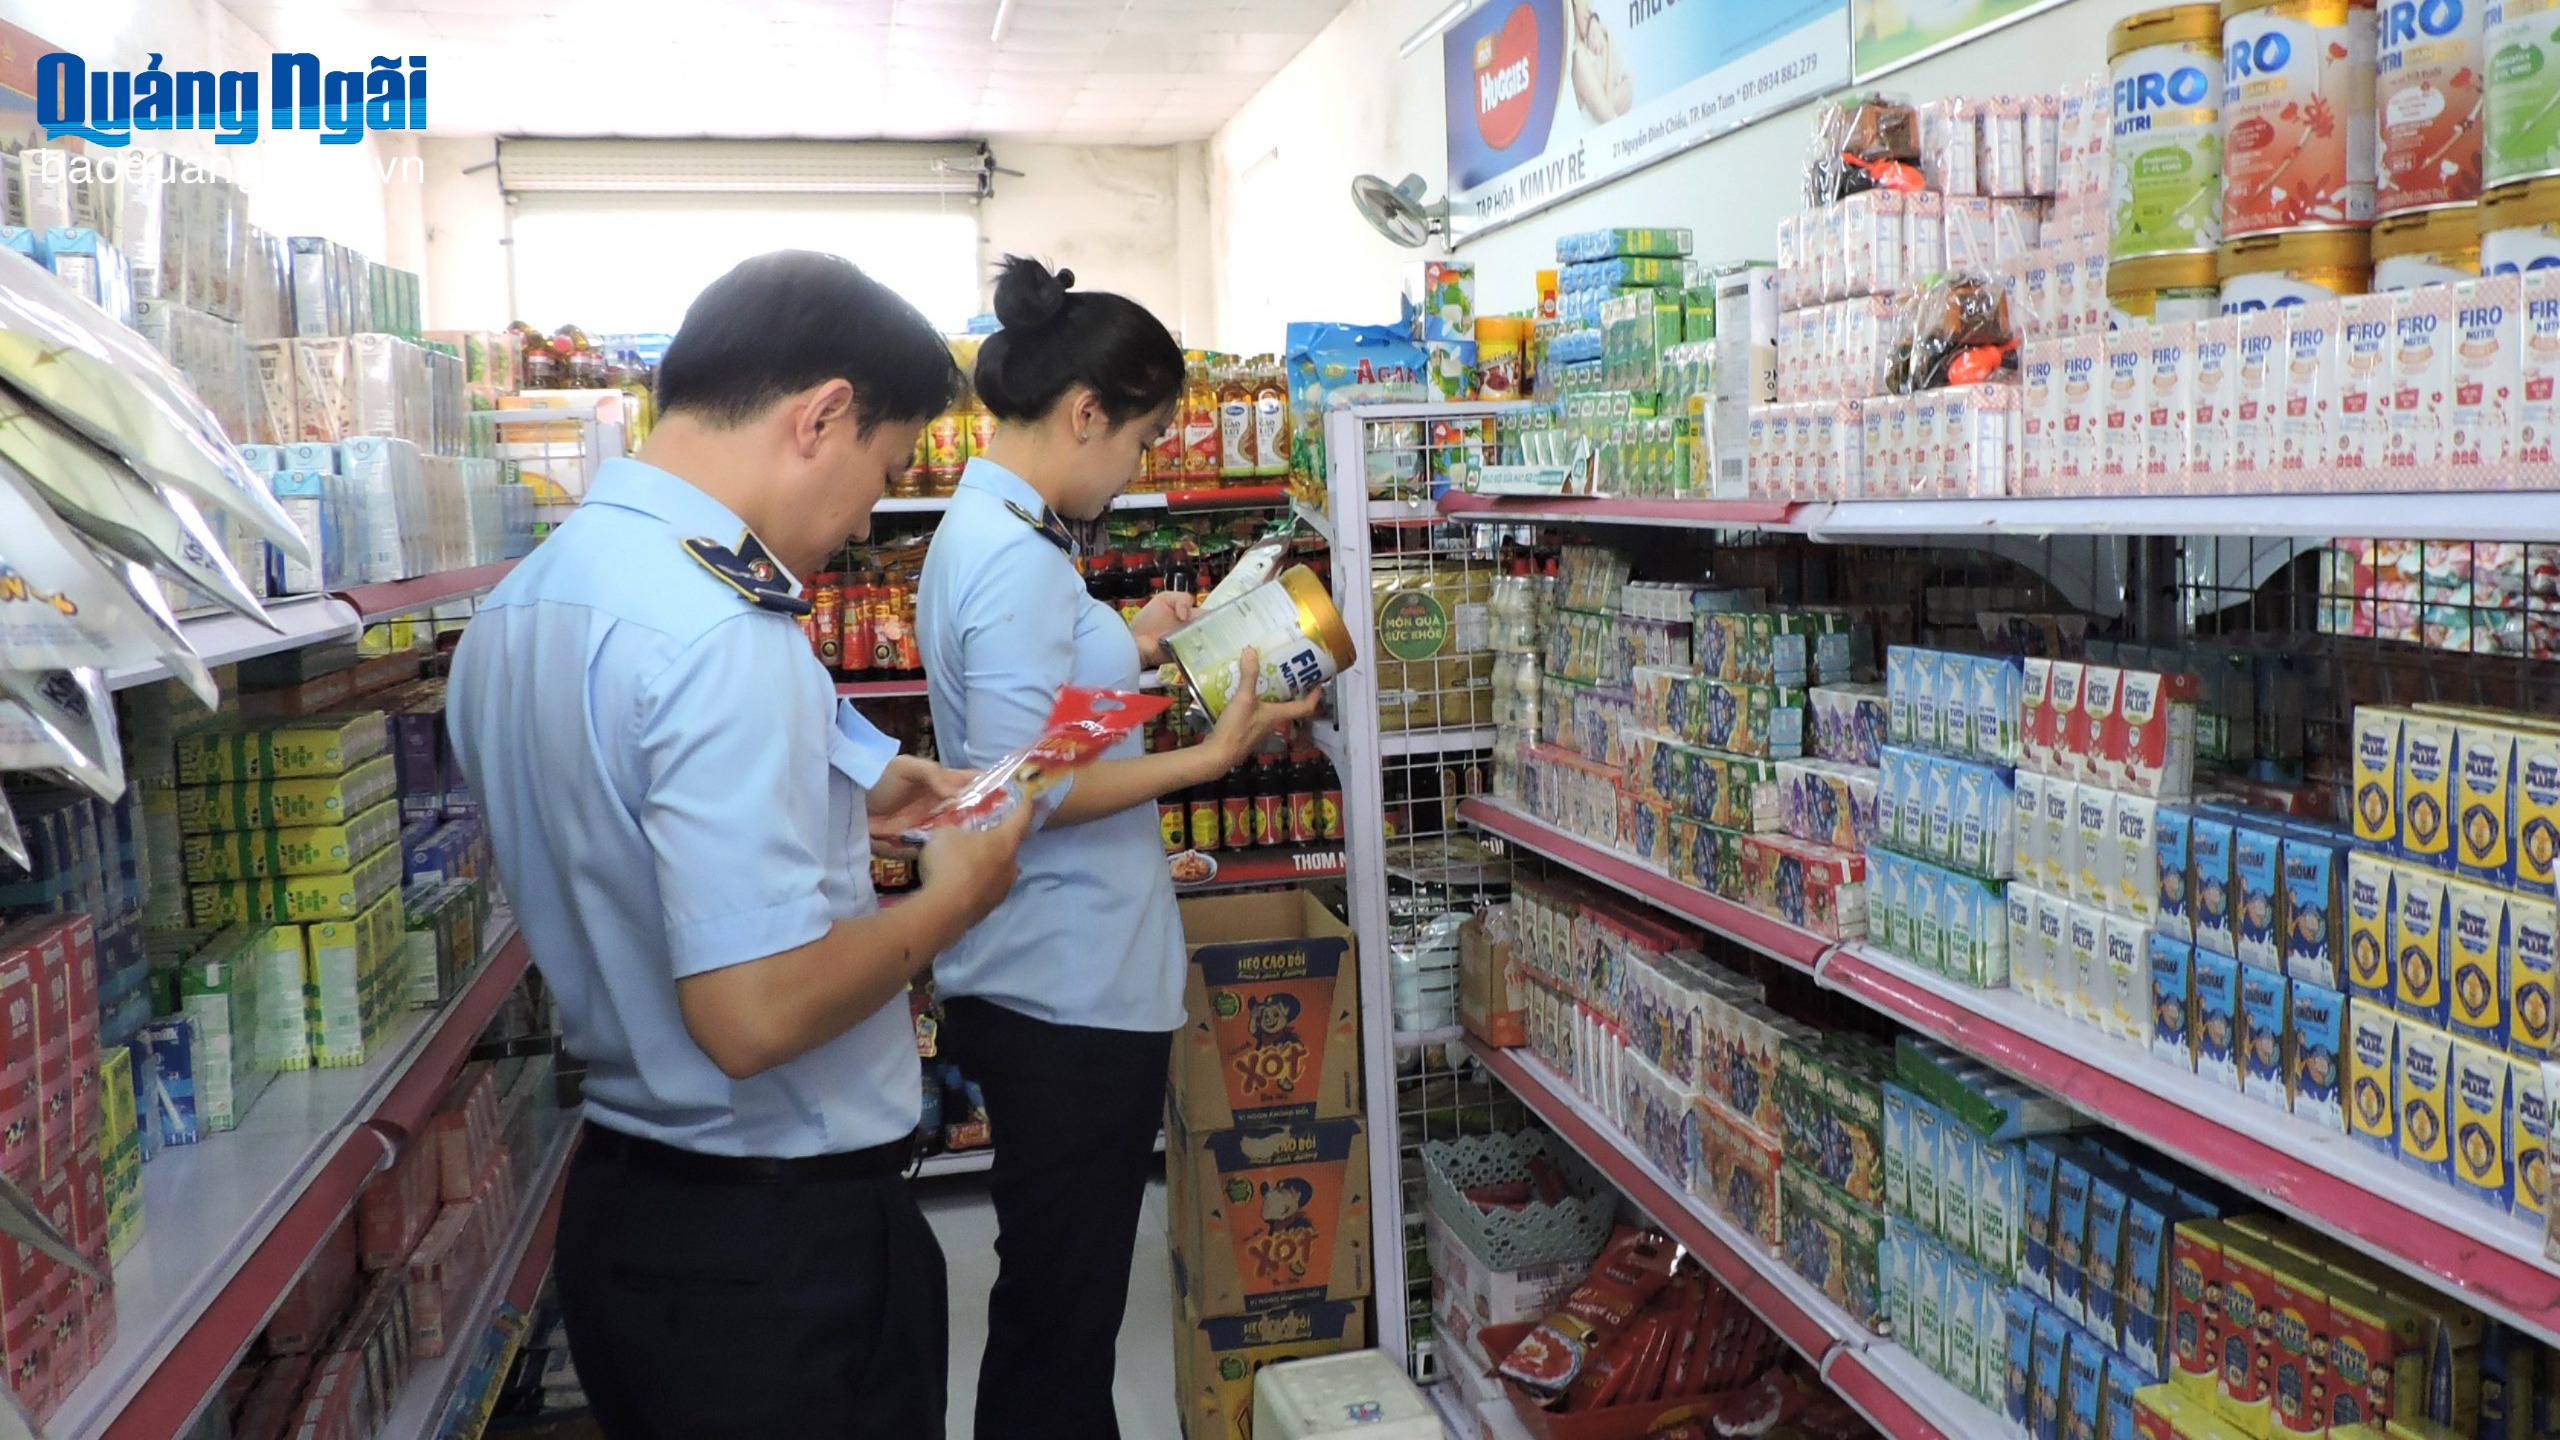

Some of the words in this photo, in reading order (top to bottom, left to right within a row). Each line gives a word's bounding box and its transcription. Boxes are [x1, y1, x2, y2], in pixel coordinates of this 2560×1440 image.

[2224, 30, 2291, 86] IRO
[1480, 56, 1529, 114] HUGGIES
[2114, 66, 2208, 116] FIRO
[1613, 142, 1621, 158] 21
[1701, 99, 1717, 119] Kon
[1718, 91, 1735, 111] Tum
[1757, 70, 1779, 94] 0934
[1781, 63, 1798, 84] 882
[1800, 52, 1818, 75] 279
[2224, 85, 2240, 107] TRI
[2063, 97, 2083, 114] FIRO
[2114, 114, 2151, 136] NUTRI
[1520, 169, 1544, 204] KIM
[1547, 158, 1564, 193] VY
[1568, 139, 1586, 185] RẺ
[2056, 262, 2075, 278] FIRO
[2086, 255, 2104, 271] FIRO
[2026, 268, 2046, 286] FIRO
[2458, 305, 2503, 328] FIRO
[2529, 298, 2560, 320] FIR
[2346, 321, 2386, 342] FIRO
[2397, 313, 2437, 335] FIRO
[2241, 335, 2272, 353] FIRO
[2290, 328, 2323, 348] FIRO
[2110, 352, 2138, 368] FIRO
[2152, 346, 2180, 365] FIRO
[2198, 342, 2226, 360] FIRO
[2026, 362, 2050, 378] FIRO
[2064, 357, 2092, 373] FIRO
[1291, 649, 1324, 689] FIR
[1280, 662, 1299, 696] NUTR
[2015, 787, 2035, 801] Grow
[2047, 793, 2066, 808] Grow
[2080, 803, 2102, 818] Grow
[2119, 811, 2144, 827] Grow
[1292, 852, 1336, 871] THƠM
[2008, 898, 2028, 913] Grow
[2039, 910, 2059, 926] Grow
[2071, 922, 2093, 938] Grow
[2108, 934, 2133, 951] Grow
